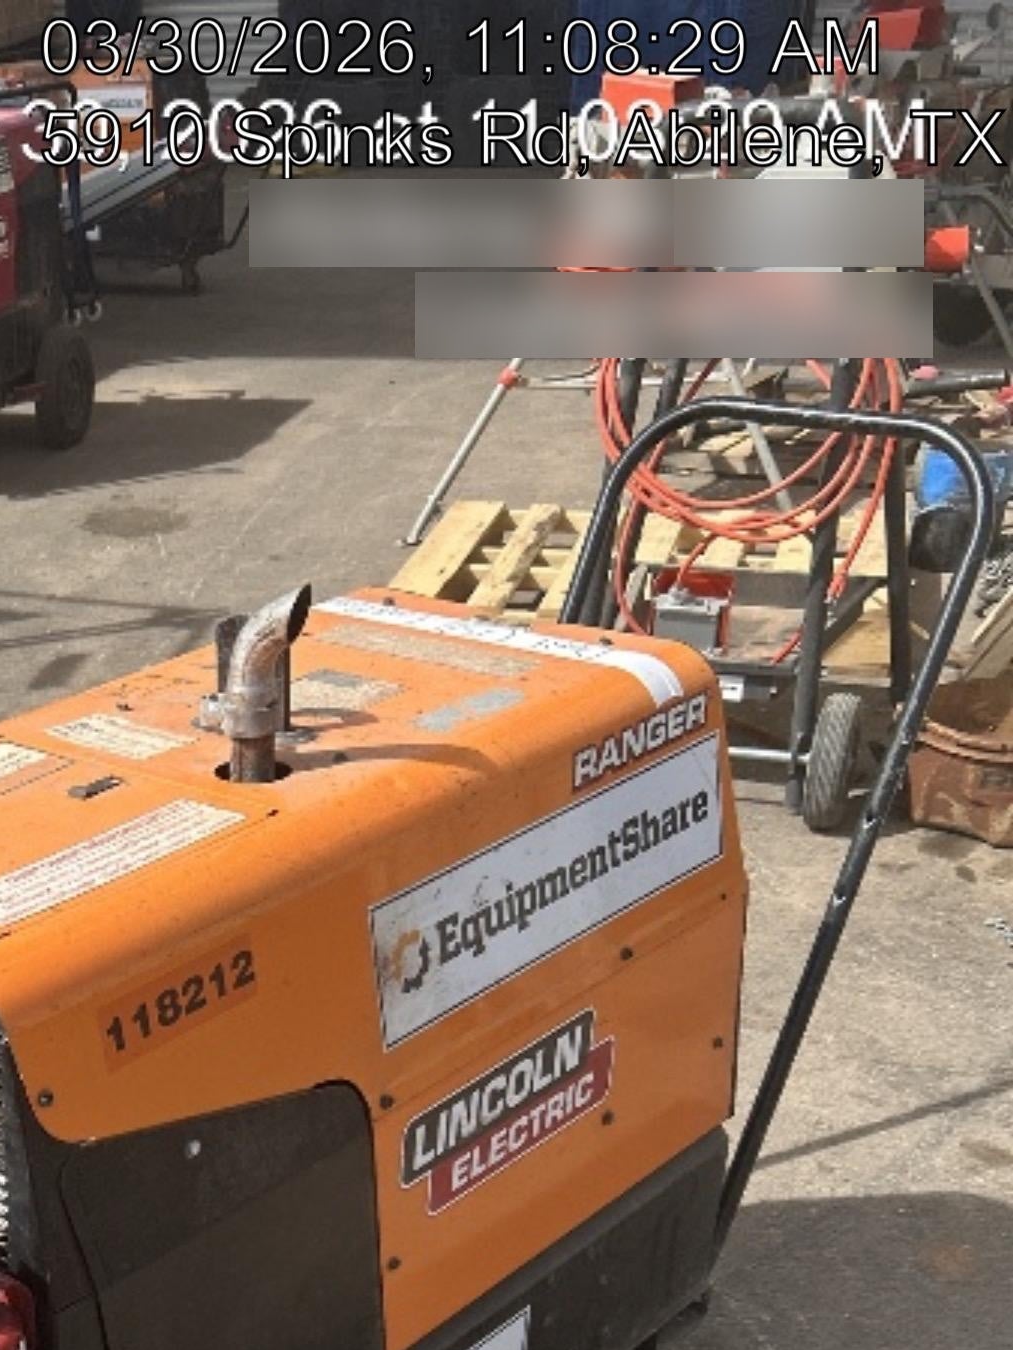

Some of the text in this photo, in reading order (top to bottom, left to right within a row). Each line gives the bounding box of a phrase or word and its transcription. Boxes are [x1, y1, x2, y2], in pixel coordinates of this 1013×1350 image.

[574, 695, 707, 788] RANGER
[434, 790, 709, 967] EquipmentShare
[106, 949, 256, 1051] 118212
[412, 1024, 583, 1171] LINCOLN
[450, 1072, 595, 1192] ELECTRIC
